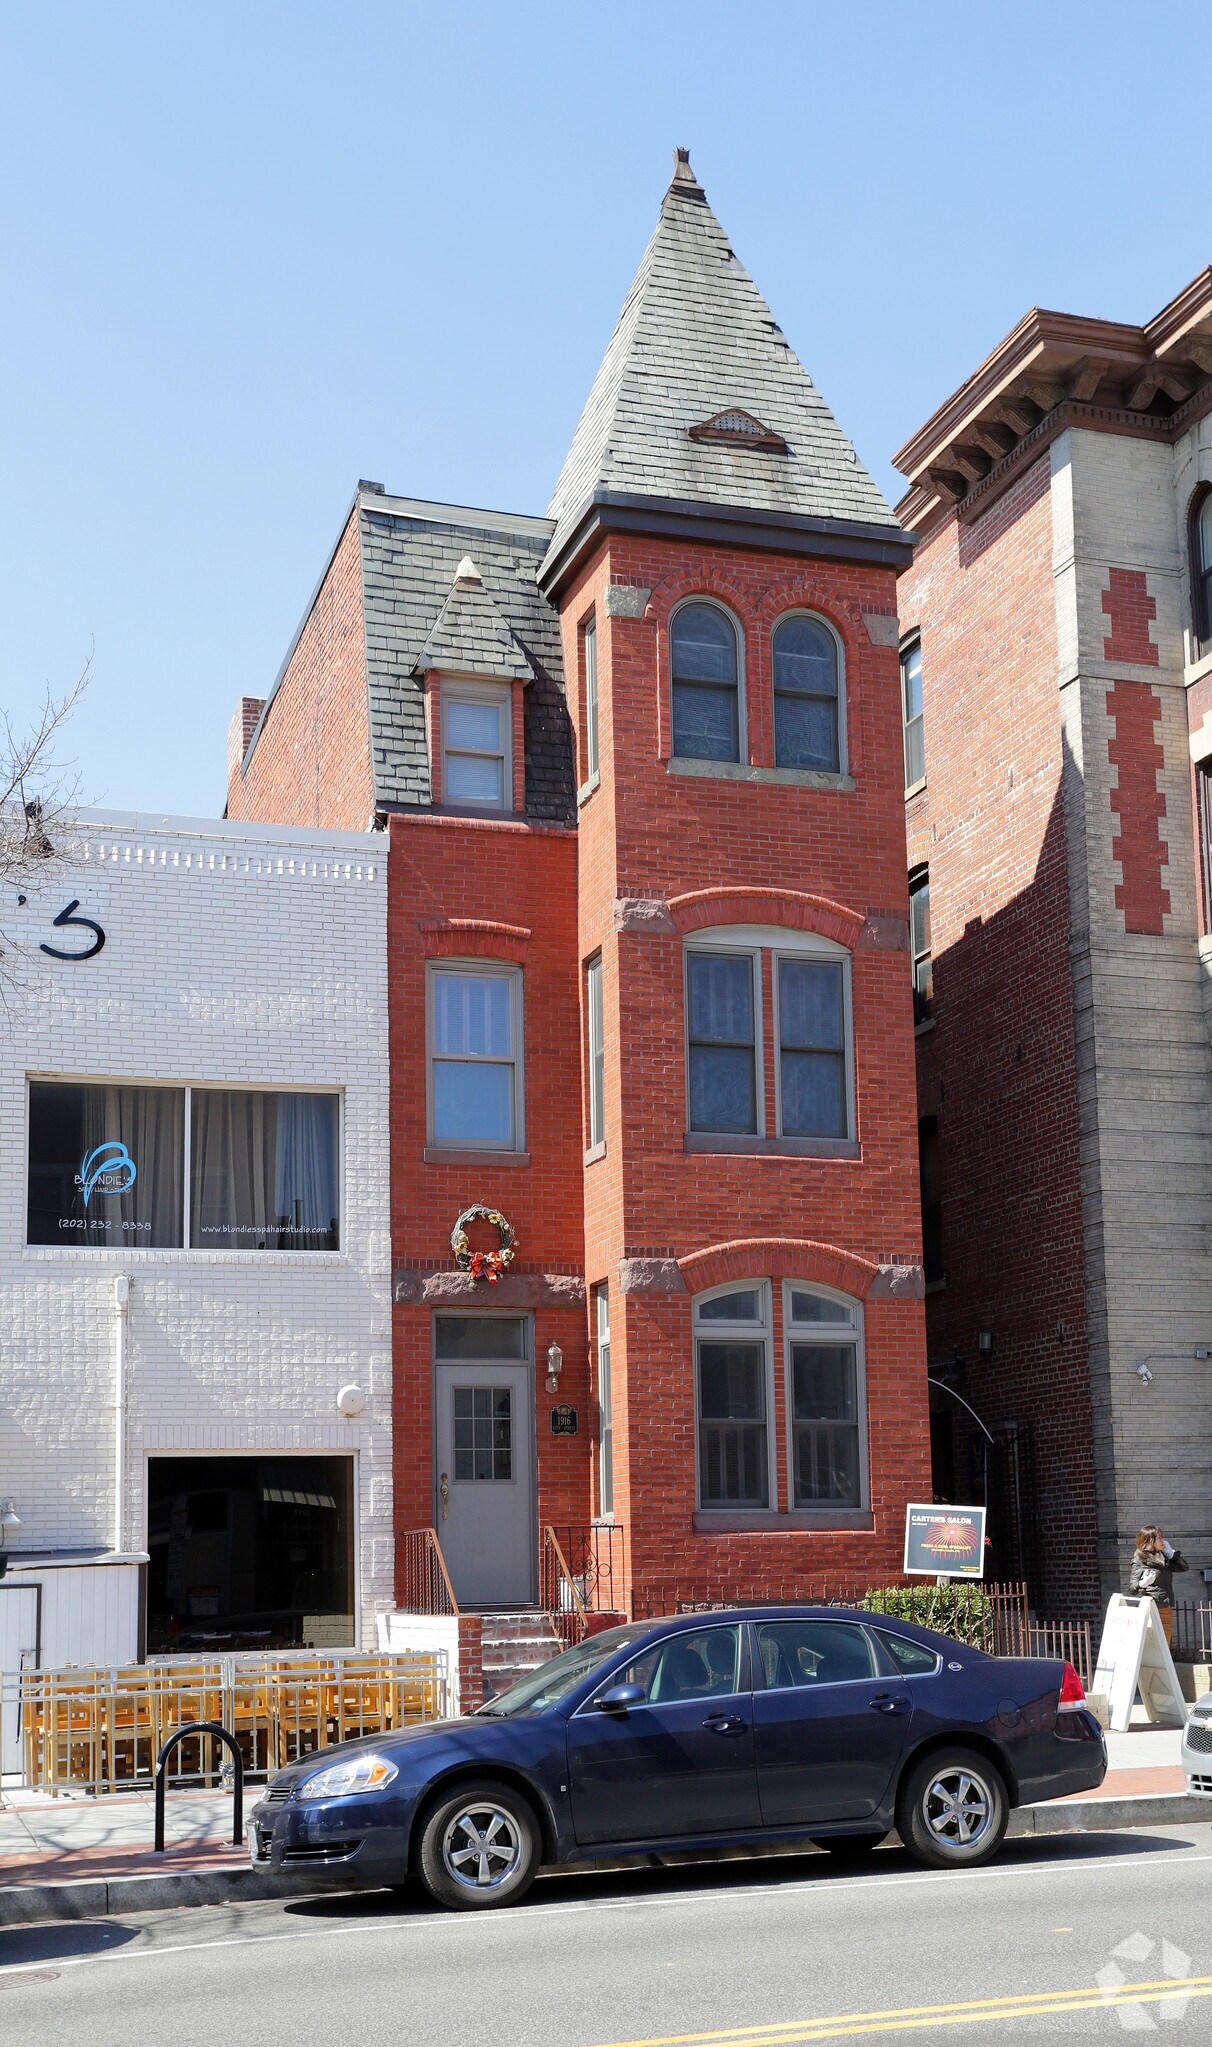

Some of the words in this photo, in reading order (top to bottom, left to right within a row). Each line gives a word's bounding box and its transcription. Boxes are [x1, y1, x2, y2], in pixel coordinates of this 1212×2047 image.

[58, 1218, 87, 1230] (202)
[90, 1220, 112, 1229] 232
[122, 1221, 152, 1231] 8338
[558, 1416, 571, 1426] 1916
[911, 1515, 946, 1524] CARTER'S
[947, 1516, 972, 1525] SALON
